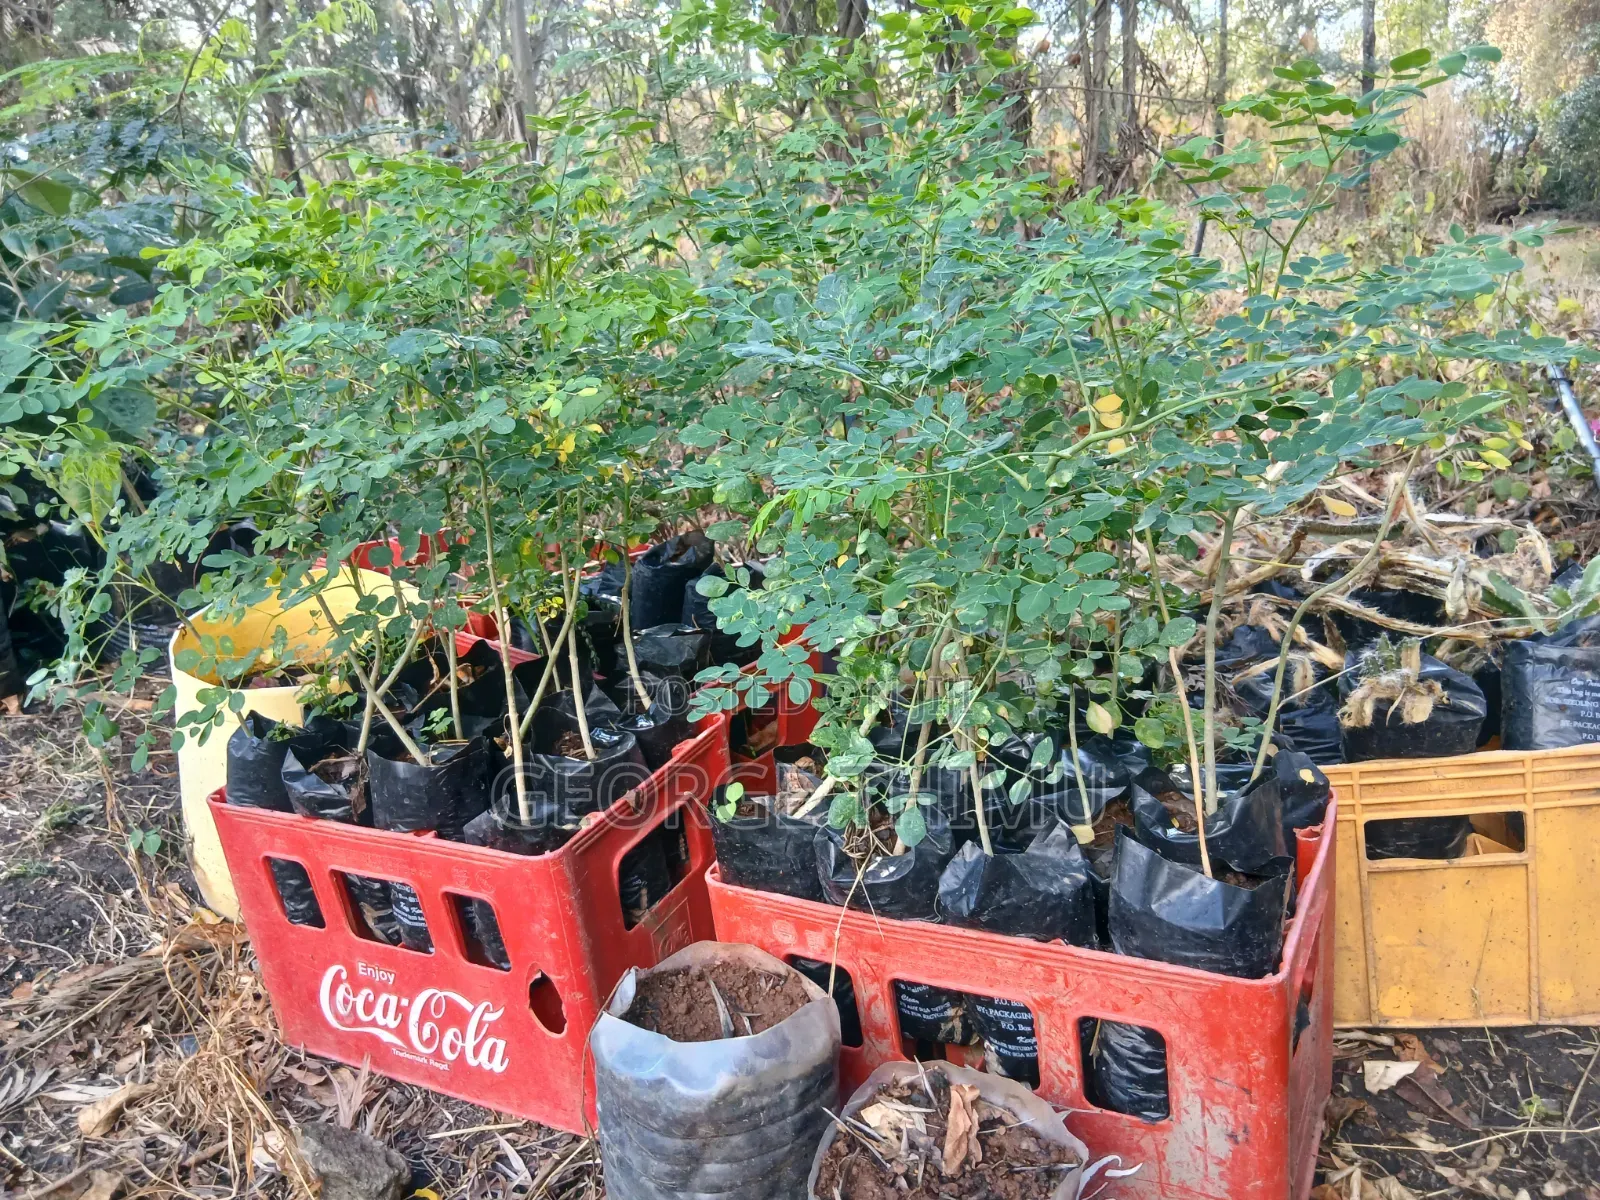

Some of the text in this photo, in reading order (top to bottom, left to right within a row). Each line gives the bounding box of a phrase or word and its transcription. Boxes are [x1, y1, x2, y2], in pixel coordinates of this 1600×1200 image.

[357, 961, 396, 985] Enjoy
[319, 964, 509, 1073] Coca-Cola
[1001, 1021, 1017, 1031] P.O.
[391, 1048, 428, 1064] Trademark
